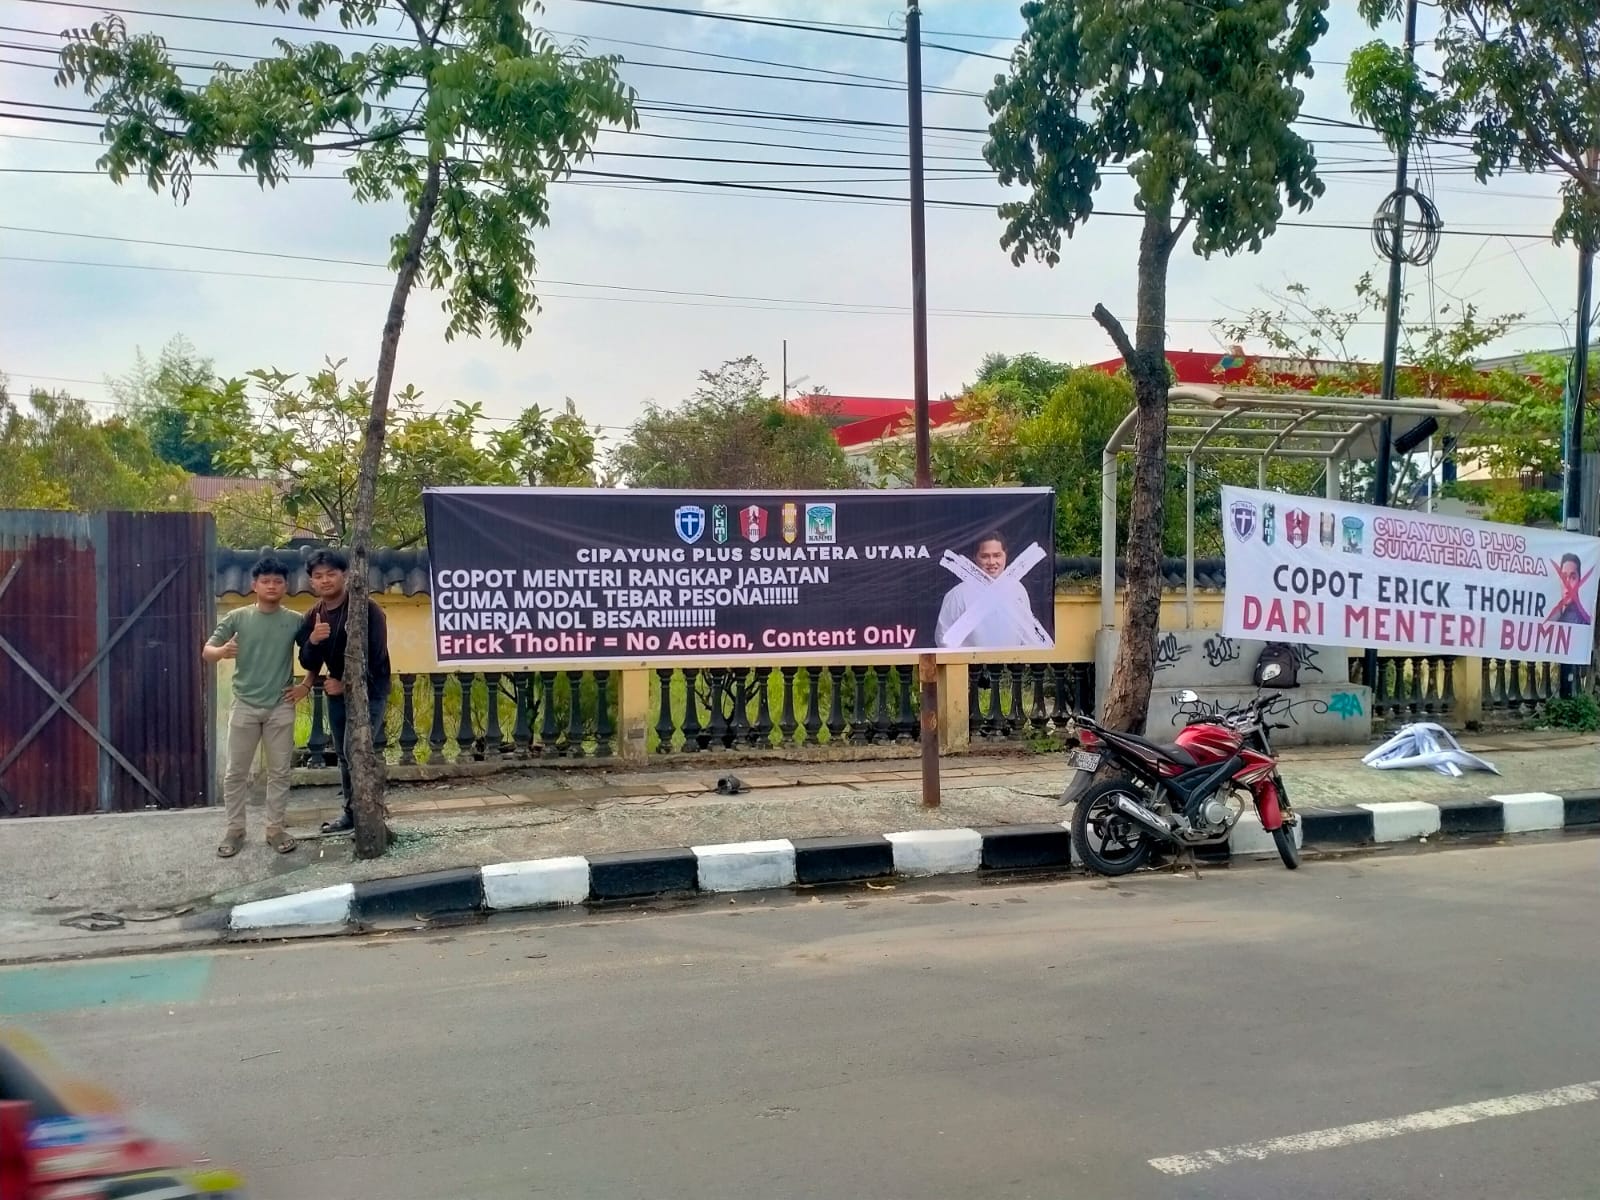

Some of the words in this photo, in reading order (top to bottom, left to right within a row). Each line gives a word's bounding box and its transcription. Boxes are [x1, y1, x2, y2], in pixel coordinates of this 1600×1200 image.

[1262, 358, 1359, 376] PERTAMIA
[1373, 516, 1476, 548] CIPAYUNG
[1479, 530, 1526, 552] PLUS
[576, 548, 685, 563] CIPAYUNG
[692, 547, 743, 562] PLUS
[749, 546, 857, 561] SUMATERA
[865, 545, 931, 560] UTARA
[1373, 538, 1481, 568] SUMATERA
[1486, 554, 1548, 576] UTARA
[437, 569, 517, 588] COPOT
[523, 569, 622, 587] MENTERI
[629, 568, 732, 586] RANGKAP
[737, 566, 829, 588] JABATAN
[438, 590, 508, 609] CUMA
[514, 589, 598, 609] MODAL
[603, 589, 673, 607] TEBAR
[679, 587, 799, 606] PESONA!!!!!!
[1273, 564, 1363, 601] COPOT
[1378, 575, 1451, 609] ERICK
[1464, 584, 1547, 618] THOHIR
[439, 611, 532, 634] KINERJA
[538, 610, 586, 629] NOL
[1242, 595, 1325, 636] DARI
[1344, 604, 1486, 649] MENTERI
[1499, 618, 1572, 656] BUMN
[440, 633, 504, 654] Erick
[511, 632, 596, 654] Thohir
[603, 637, 618, 647] =
[627, 631, 660, 650] No
[667, 630, 754, 650] Action,
[762, 627, 856, 647] Content
[863, 625, 917, 648] Only
